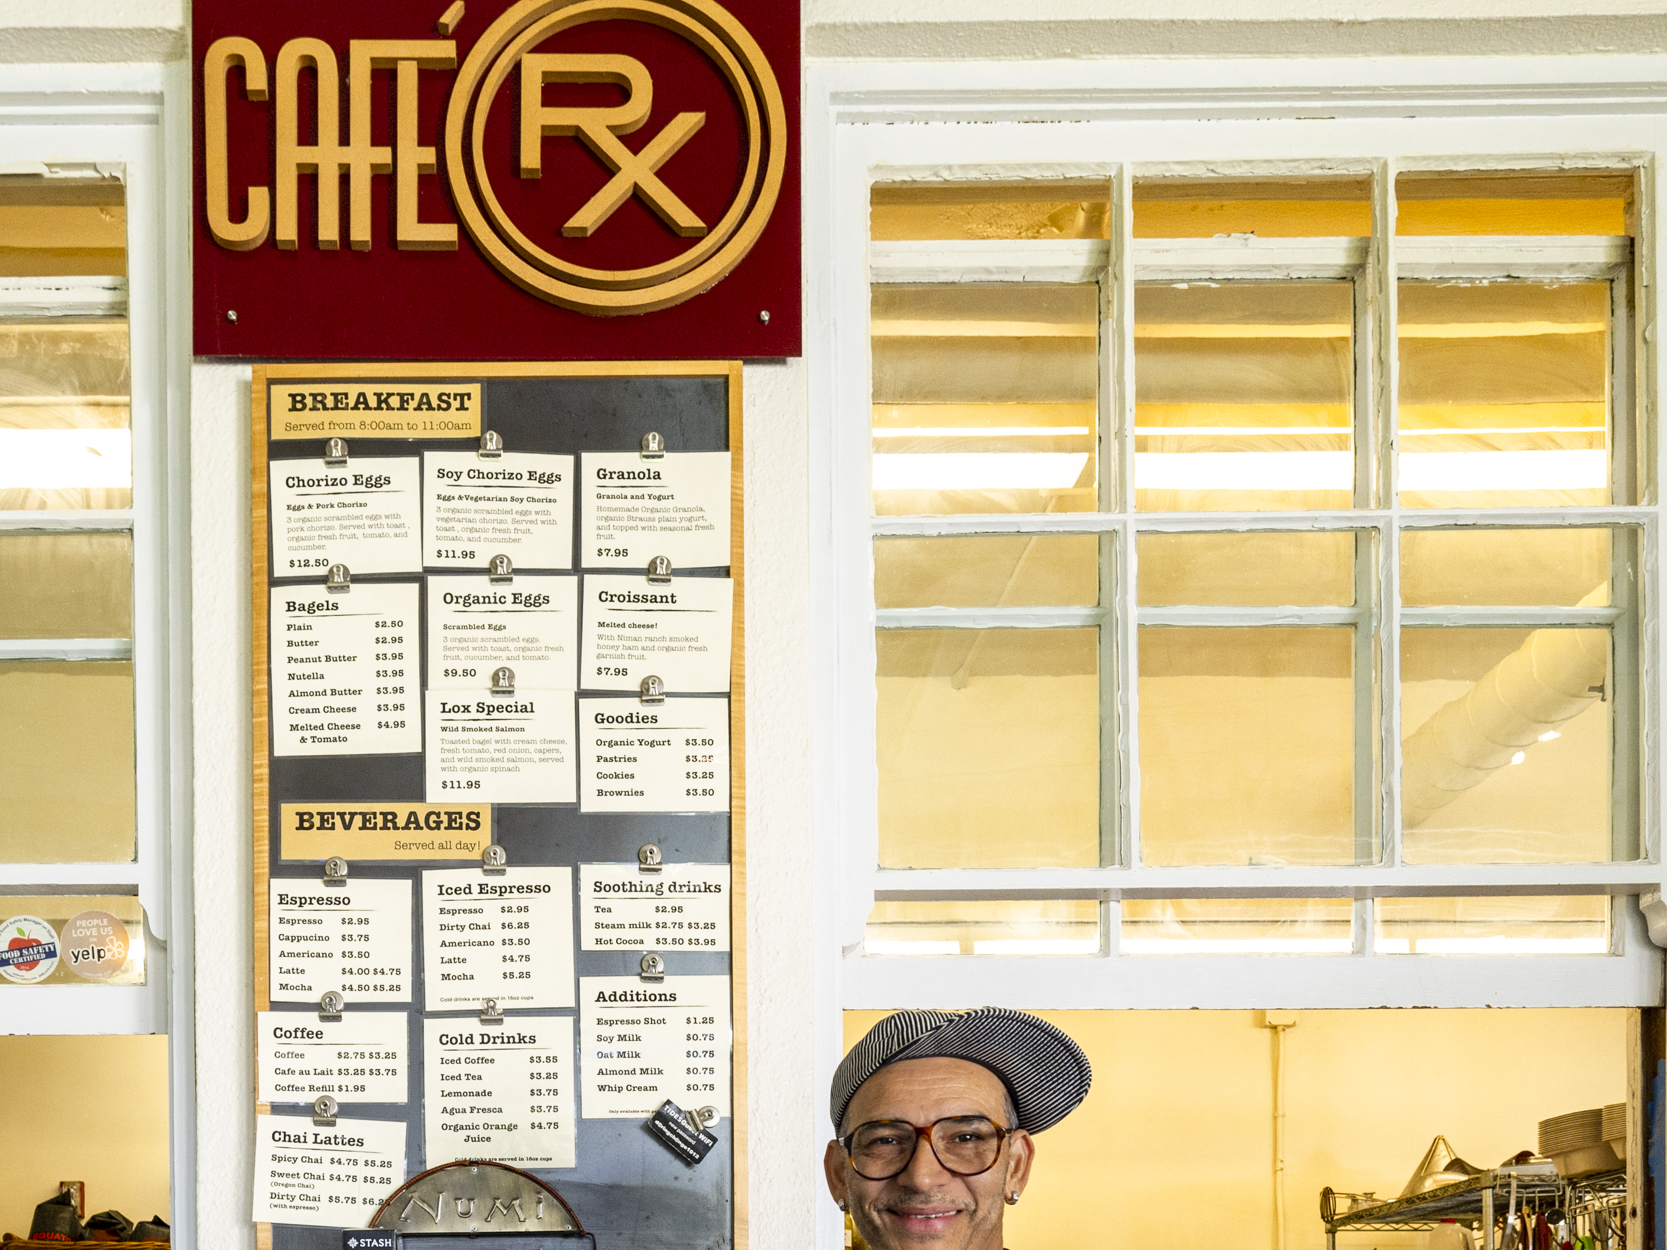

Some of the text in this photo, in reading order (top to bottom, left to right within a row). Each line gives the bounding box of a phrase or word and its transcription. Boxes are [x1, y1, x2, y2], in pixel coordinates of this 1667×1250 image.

[203, 0, 459, 251] CAFÉ
[287, 391, 472, 413] BREAKFAST
[284, 420, 473, 432] Served from 8:00am to 11:00am
[436, 468, 562, 485] Soy Chorizo Eggs
[596, 467, 662, 481] Granola
[285, 474, 392, 489] Chorizo Eggs
[596, 492, 629, 500] Granola
[646, 493, 675, 502] Yogurt
[286, 503, 305, 511] Eggs
[315, 502, 336, 510] Pork
[336, 501, 368, 509] Chorizo
[436, 549, 476, 560] $11.95
[596, 547, 629, 558] $7.95
[289, 558, 329, 568] $12.50
[442, 591, 550, 608] Organic Eggs
[598, 590, 677, 605] Croissant
[285, 600, 339, 614] Bagels
[286, 619, 404, 632] Plain $2.50
[442, 623, 507, 632] Scrambled Eggs
[597, 621, 626, 629] Melted
[286, 636, 404, 648] Butter $2.95
[596, 633, 699, 643] With Niman ranch smoked
[287, 669, 405, 681] Nutella $3.95
[443, 668, 477, 678] $9.50
[596, 666, 628, 677] $7.95
[440, 700, 535, 716] Lox Special
[594, 711, 659, 725] Goodies
[494, 725, 526, 733] Salmon
[595, 738, 715, 749] Organic Yogurt $3.50
[596, 771, 715, 780] Cookies $3.25
[441, 780, 481, 790] $11.95
[294, 810, 481, 832] BEVERAGES
[394, 840, 481, 852] Served all day!
[437, 883, 551, 896] Iced Espresso
[593, 880, 722, 897] Soothing drinks
[277, 893, 351, 907] Espresso
[593, 905, 684, 914] Tea $2.95
[76, 918, 108, 927] PEOPLE
[439, 921, 530, 933] Dirty Chai $6.25
[594, 921, 716, 930] Steam milk $2.75 $3.25
[72, 927, 113, 937] LOVE US
[278, 933, 370, 943] Cappucino $3.75
[439, 937, 531, 948] Americano $3.50
[22, 944, 55, 956] SAFETY
[71, 945, 106, 963] yelp
[9, 953, 46, 965] CERTIFIED
[278, 966, 402, 976] Latte $4.00 $4.75
[594, 989, 677, 1003] Additions
[596, 1016, 715, 1027] Espresso Shot $1.25
[272, 1026, 324, 1040] Coffee
[438, 1032, 537, 1046] Cold Drinks
[274, 1067, 296, 1076] Cafe
[313, 1067, 334, 1076] Lait
[337, 1068, 366, 1076] $3.25
[368, 1068, 398, 1077] $3.75
[440, 1088, 559, 1098] Lemonade $3.75
[271, 1130, 365, 1148] Chai Lattes
[270, 1170, 392, 1185] Sweet Chai $4.75 $5.25
[270, 1181, 297, 1189] (Oregon
[359, 1238, 392, 1248] STASH
